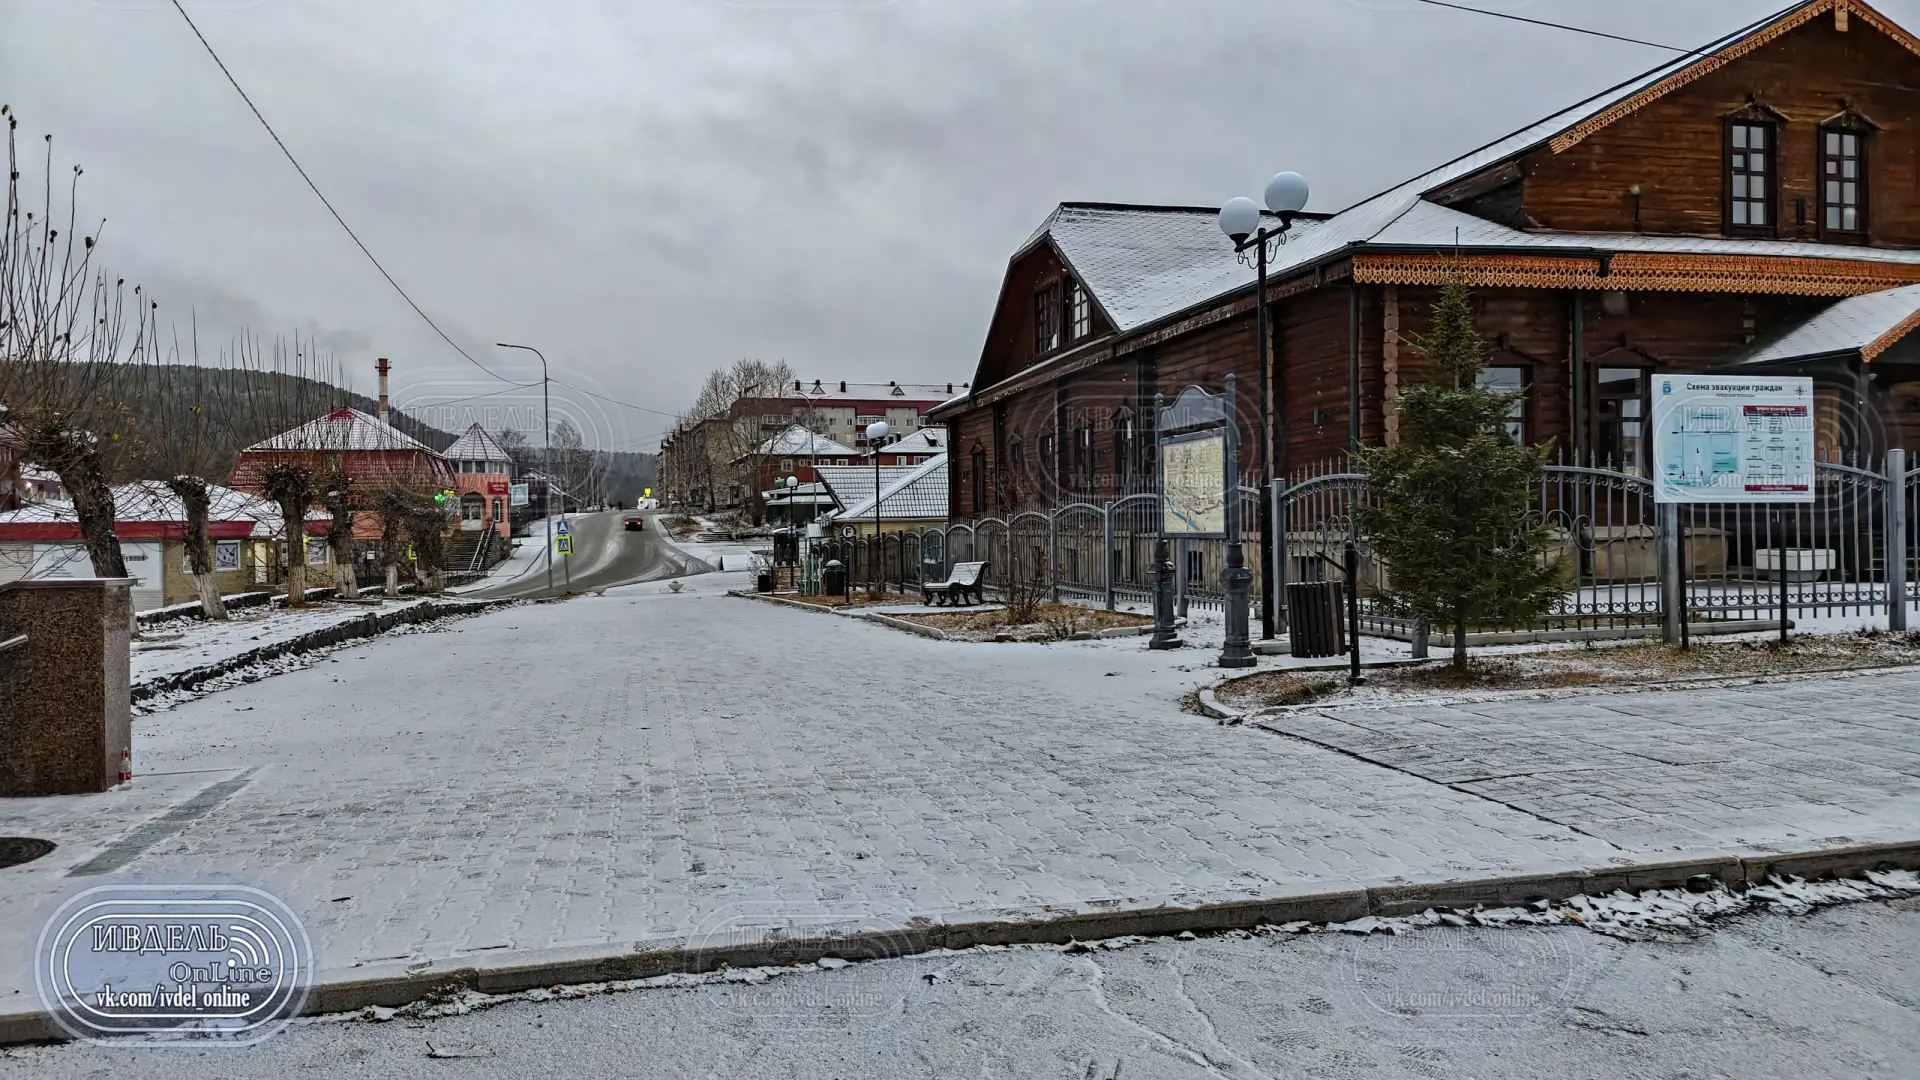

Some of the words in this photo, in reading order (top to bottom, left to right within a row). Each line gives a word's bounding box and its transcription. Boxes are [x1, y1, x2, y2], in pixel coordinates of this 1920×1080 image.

[1686, 382, 1710, 391] Схема
[1711, 384, 1750, 392] эвакуации
[1752, 385, 1783, 393] граждан
